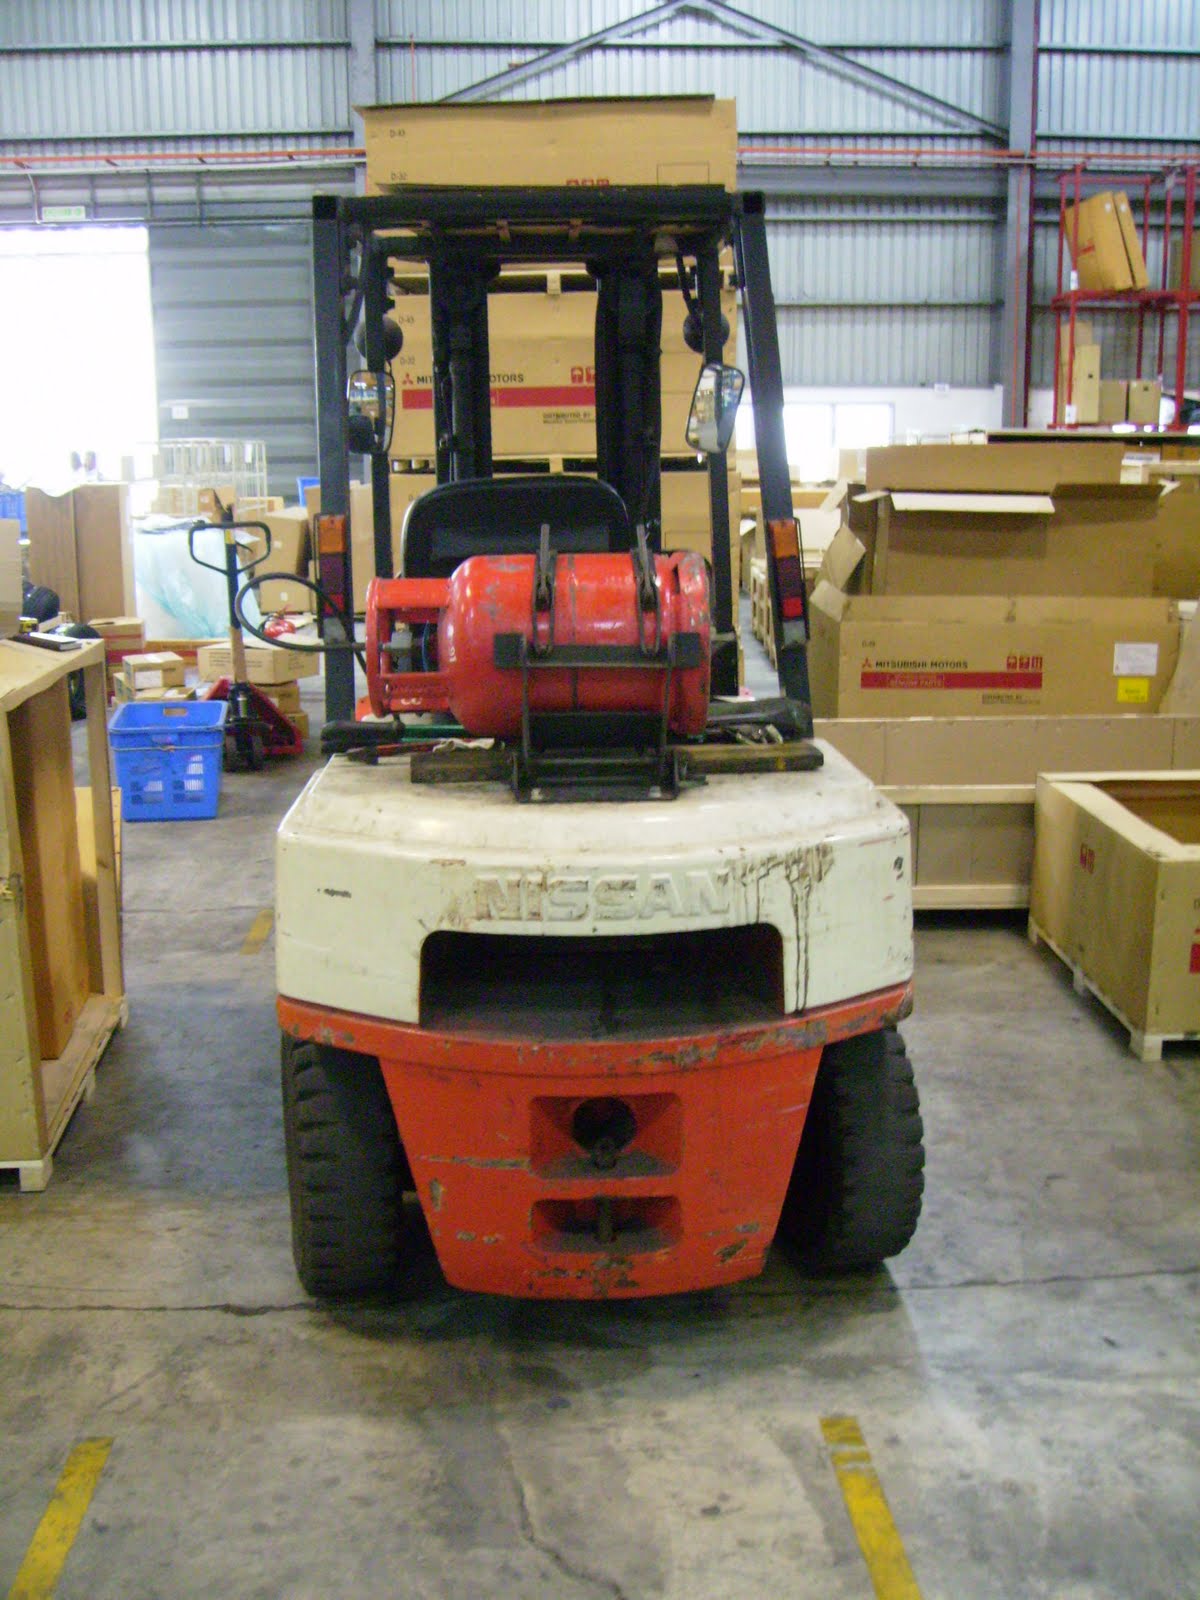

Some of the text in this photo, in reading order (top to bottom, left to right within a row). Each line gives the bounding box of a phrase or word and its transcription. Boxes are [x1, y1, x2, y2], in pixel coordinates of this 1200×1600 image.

[489, 373, 524, 384] OTORS
[875, 659, 968, 669] MITSUBISHI MOTORS
[475, 870, 731, 922] NISSAN
